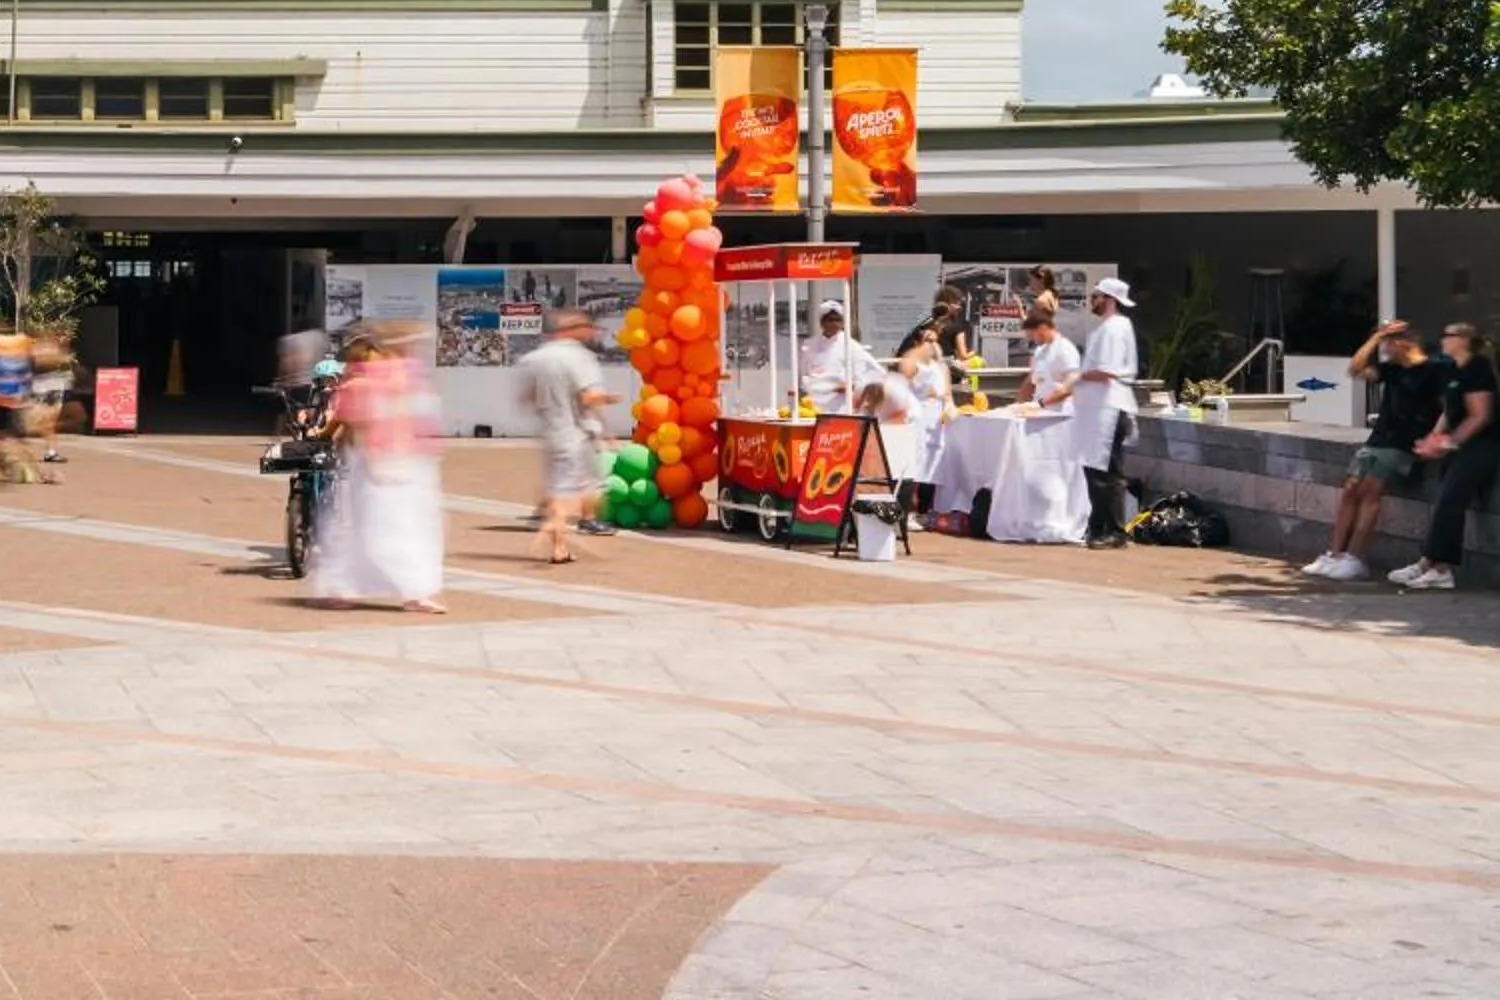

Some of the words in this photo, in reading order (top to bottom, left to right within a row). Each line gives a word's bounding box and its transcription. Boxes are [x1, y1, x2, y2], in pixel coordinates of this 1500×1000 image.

[846, 107, 904, 131] APEROL
[858, 122, 894, 140] SPRITZ
[501, 319, 522, 329] KEEP
[524, 319, 541, 329] OUT
[982, 321, 1004, 332] KEEP
